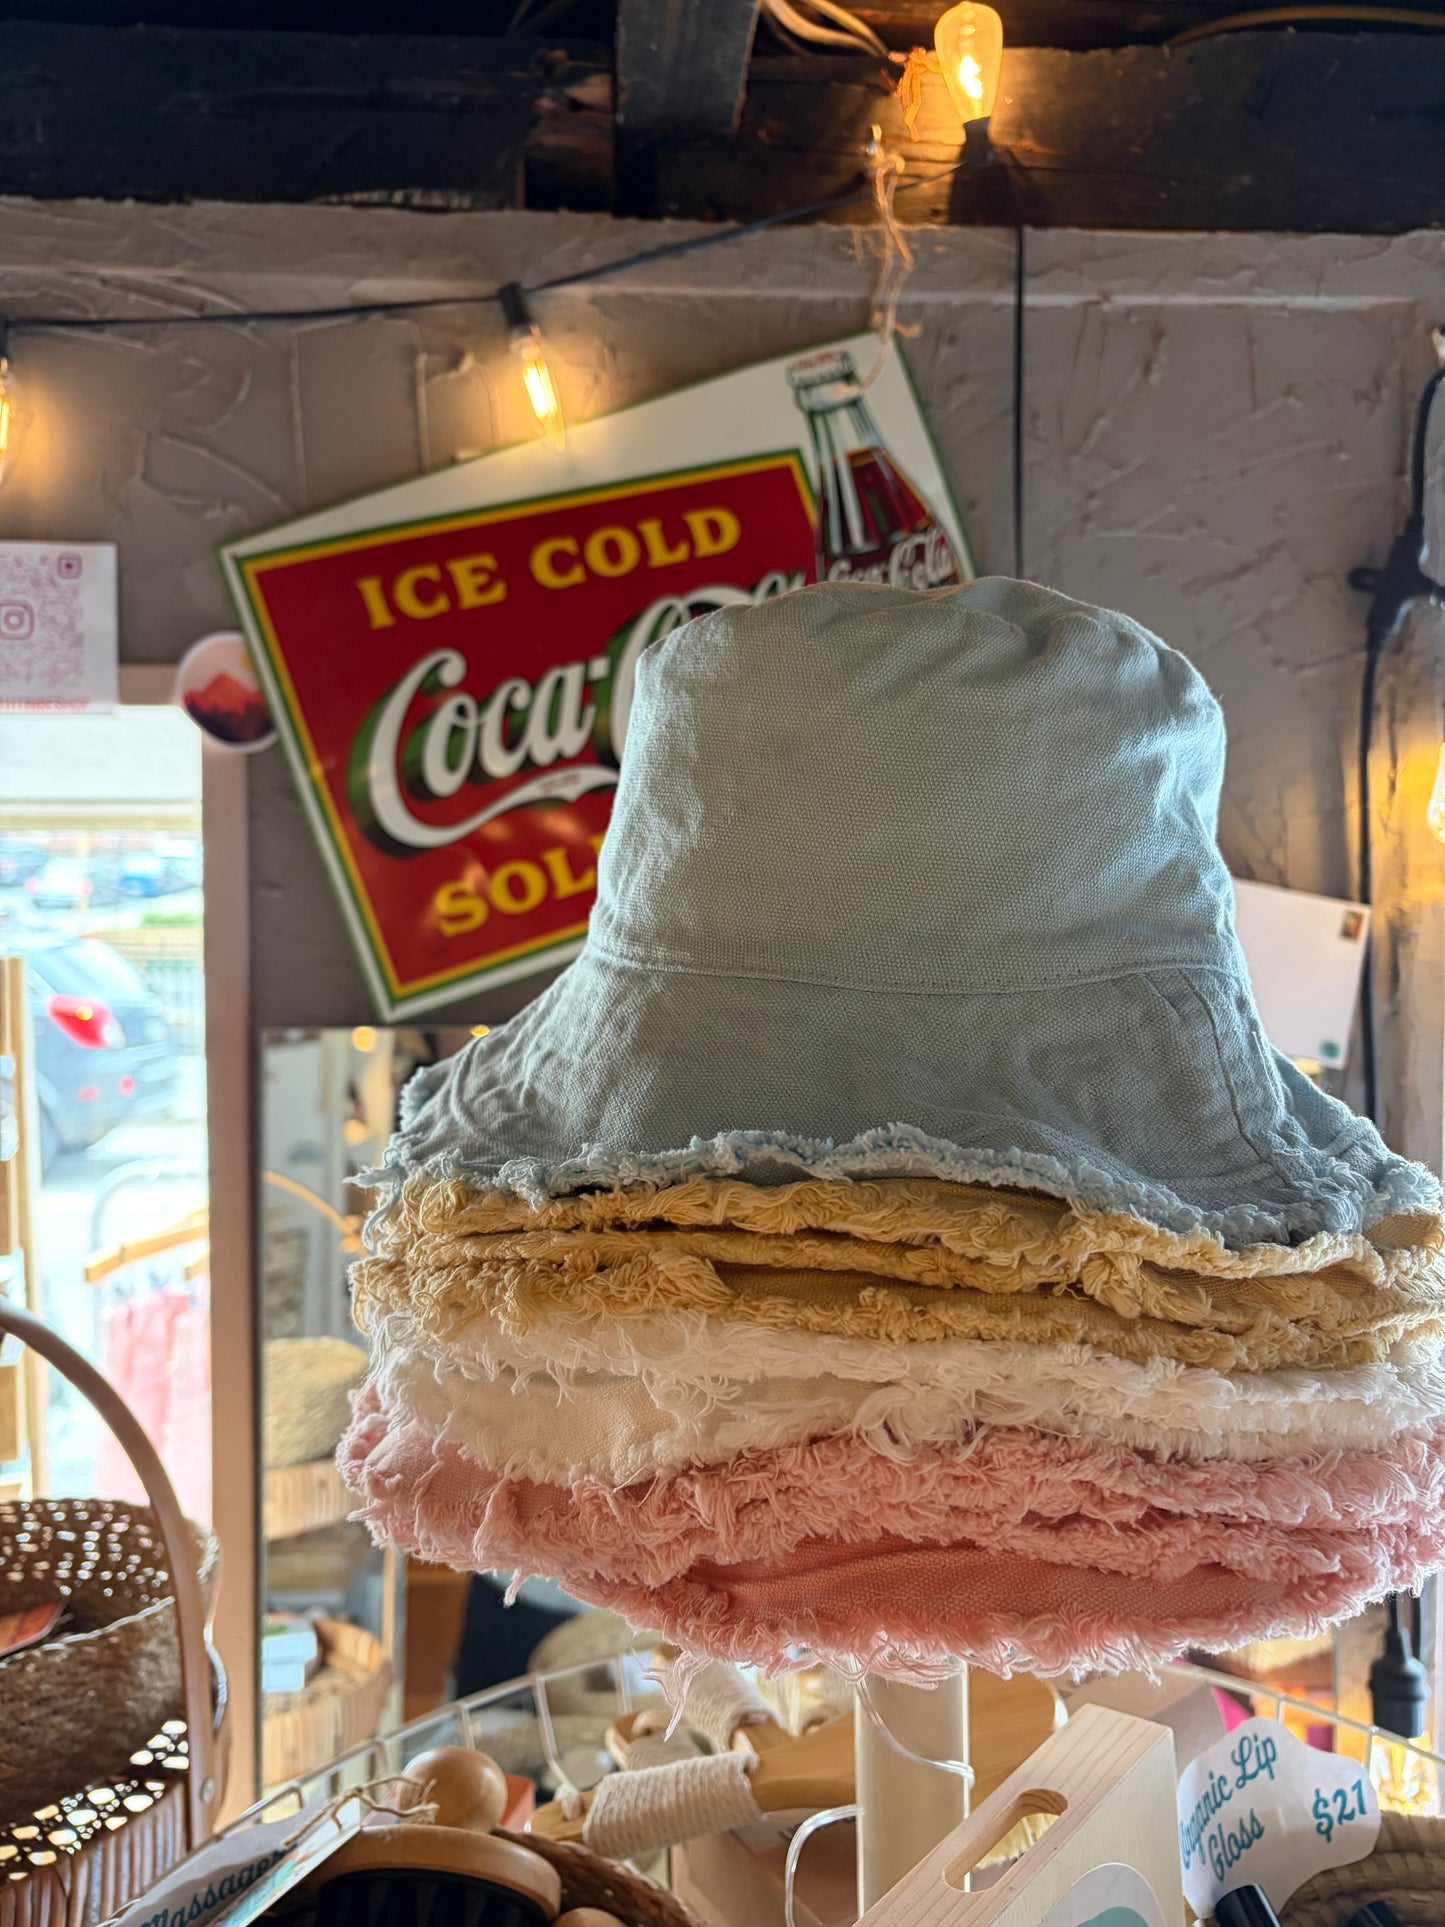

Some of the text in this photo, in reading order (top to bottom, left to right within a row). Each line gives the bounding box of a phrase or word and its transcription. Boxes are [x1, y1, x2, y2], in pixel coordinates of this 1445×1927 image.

[356, 507, 742, 630] ICE COLD
[366, 572, 806, 849] Coca-C
[434, 833, 606, 938] SOL
[1180, 1735, 1278, 1870] Organic Lip
[1207, 1808, 1265, 1883] Gloss
[1312, 1778, 1367, 1843] $21
